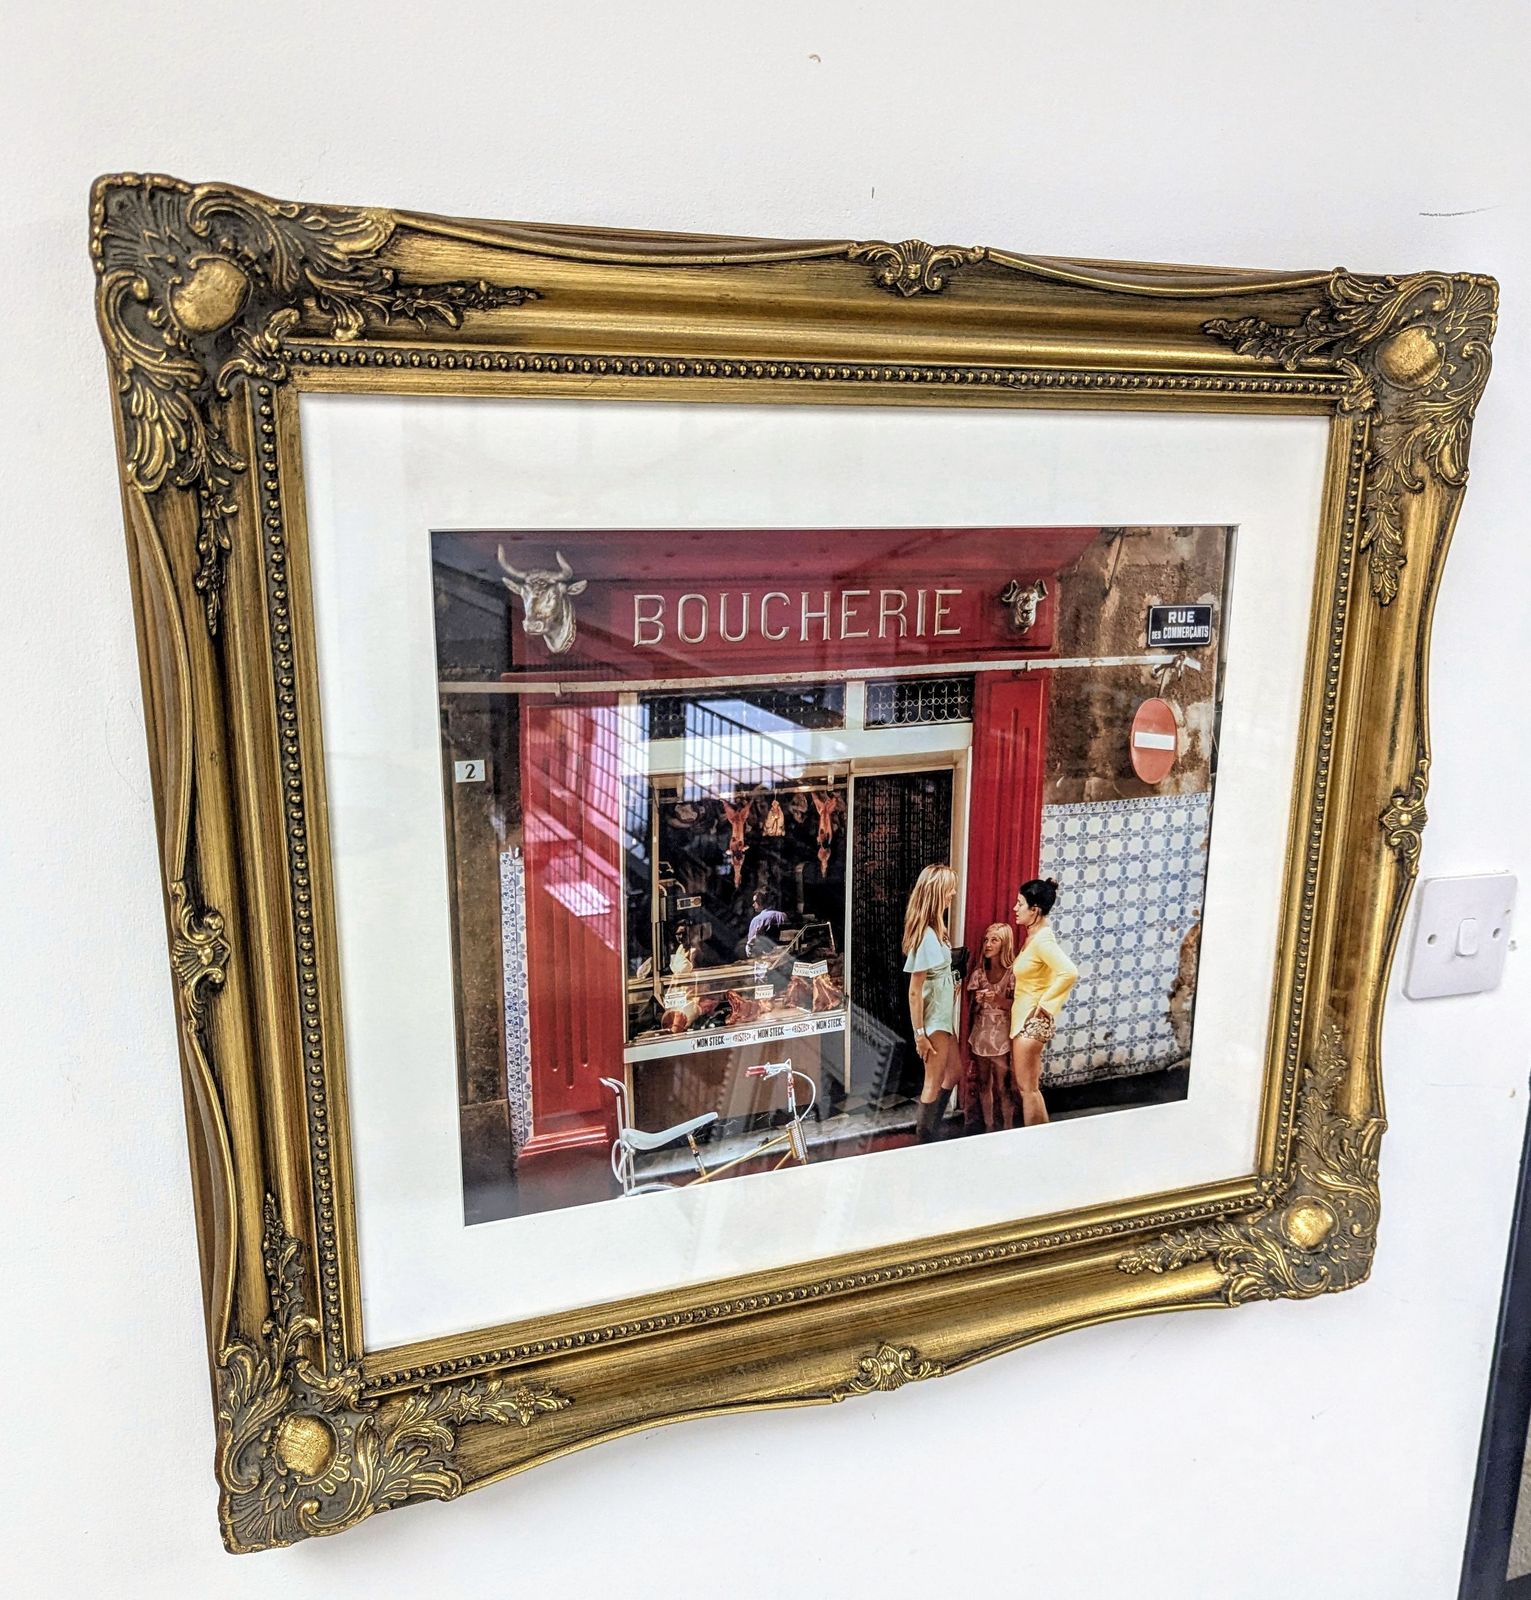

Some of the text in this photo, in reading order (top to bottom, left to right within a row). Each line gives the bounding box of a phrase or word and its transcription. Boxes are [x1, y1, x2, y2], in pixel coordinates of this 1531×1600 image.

[633, 590, 963, 648] BOUCHERIE
[1168, 611, 1195, 623] RUE
[1151, 625, 1209, 640] DES COMMERÇANTS
[465, 763, 476, 779] 2
